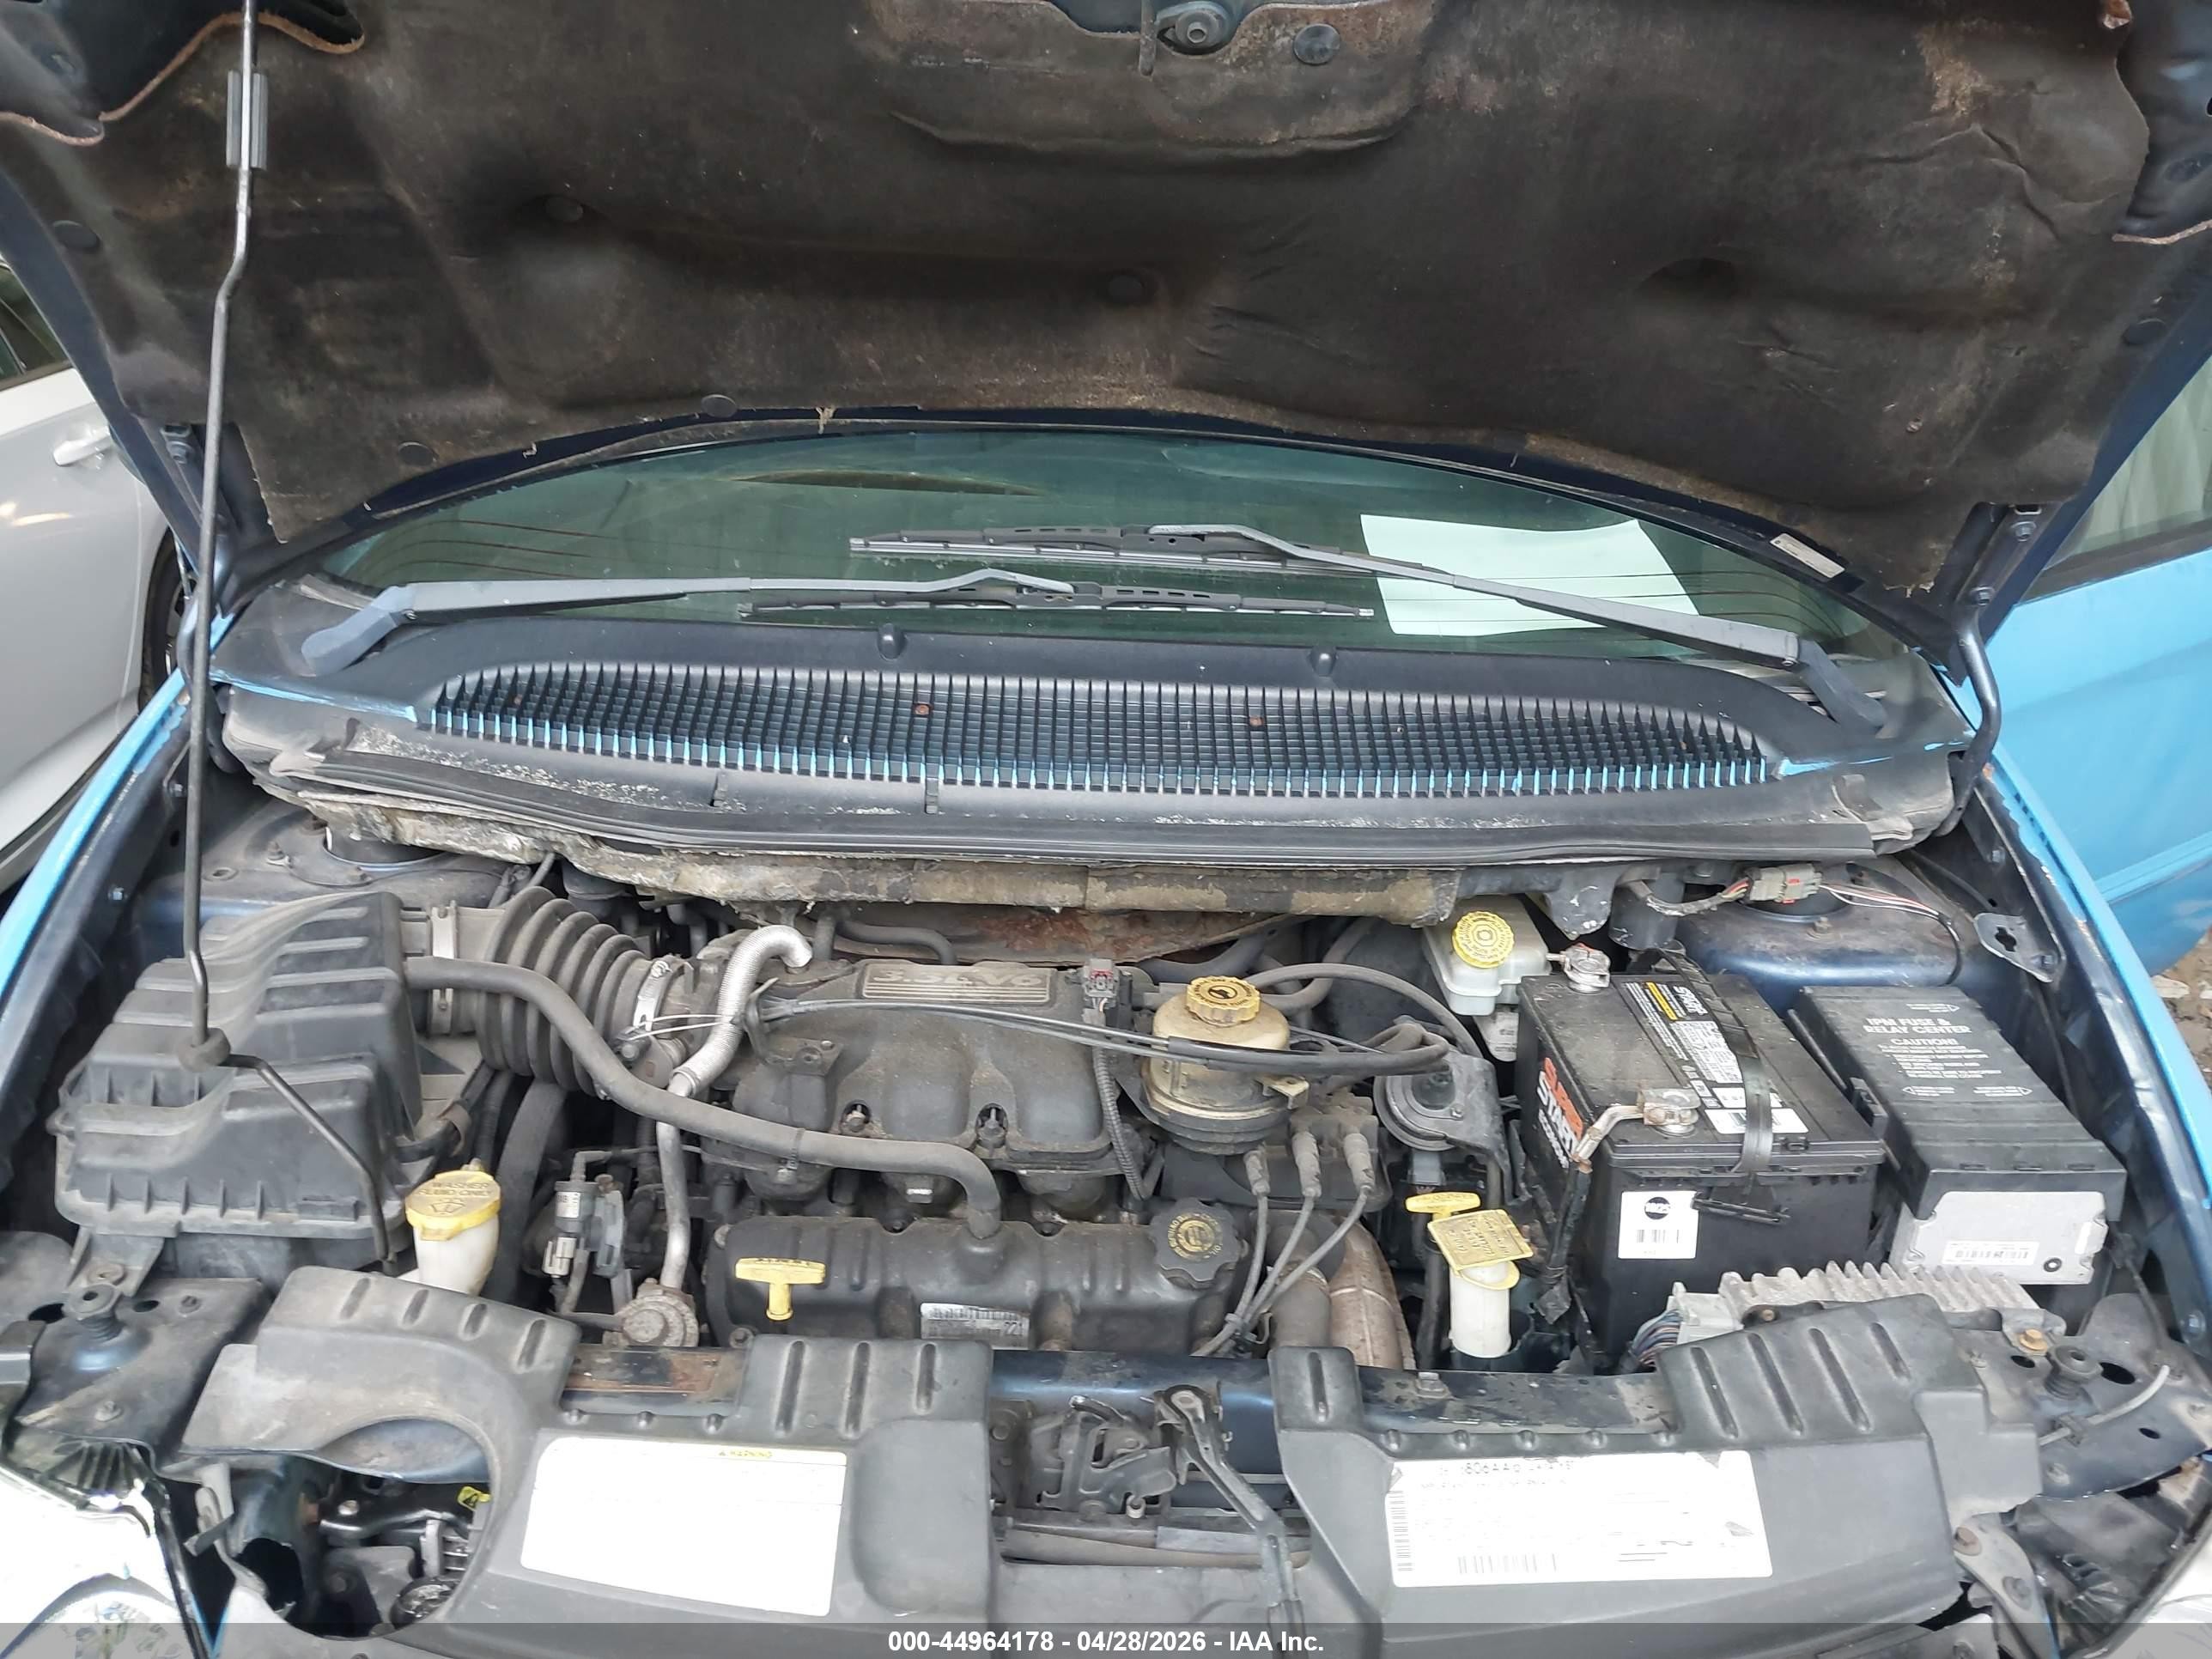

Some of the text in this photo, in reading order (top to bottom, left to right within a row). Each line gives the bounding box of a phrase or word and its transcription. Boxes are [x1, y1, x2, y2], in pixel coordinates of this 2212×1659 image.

[1863, 1025, 1972, 1034] RELAY CENTER
[1889, 1037, 1959, 1046] CAUTION!
